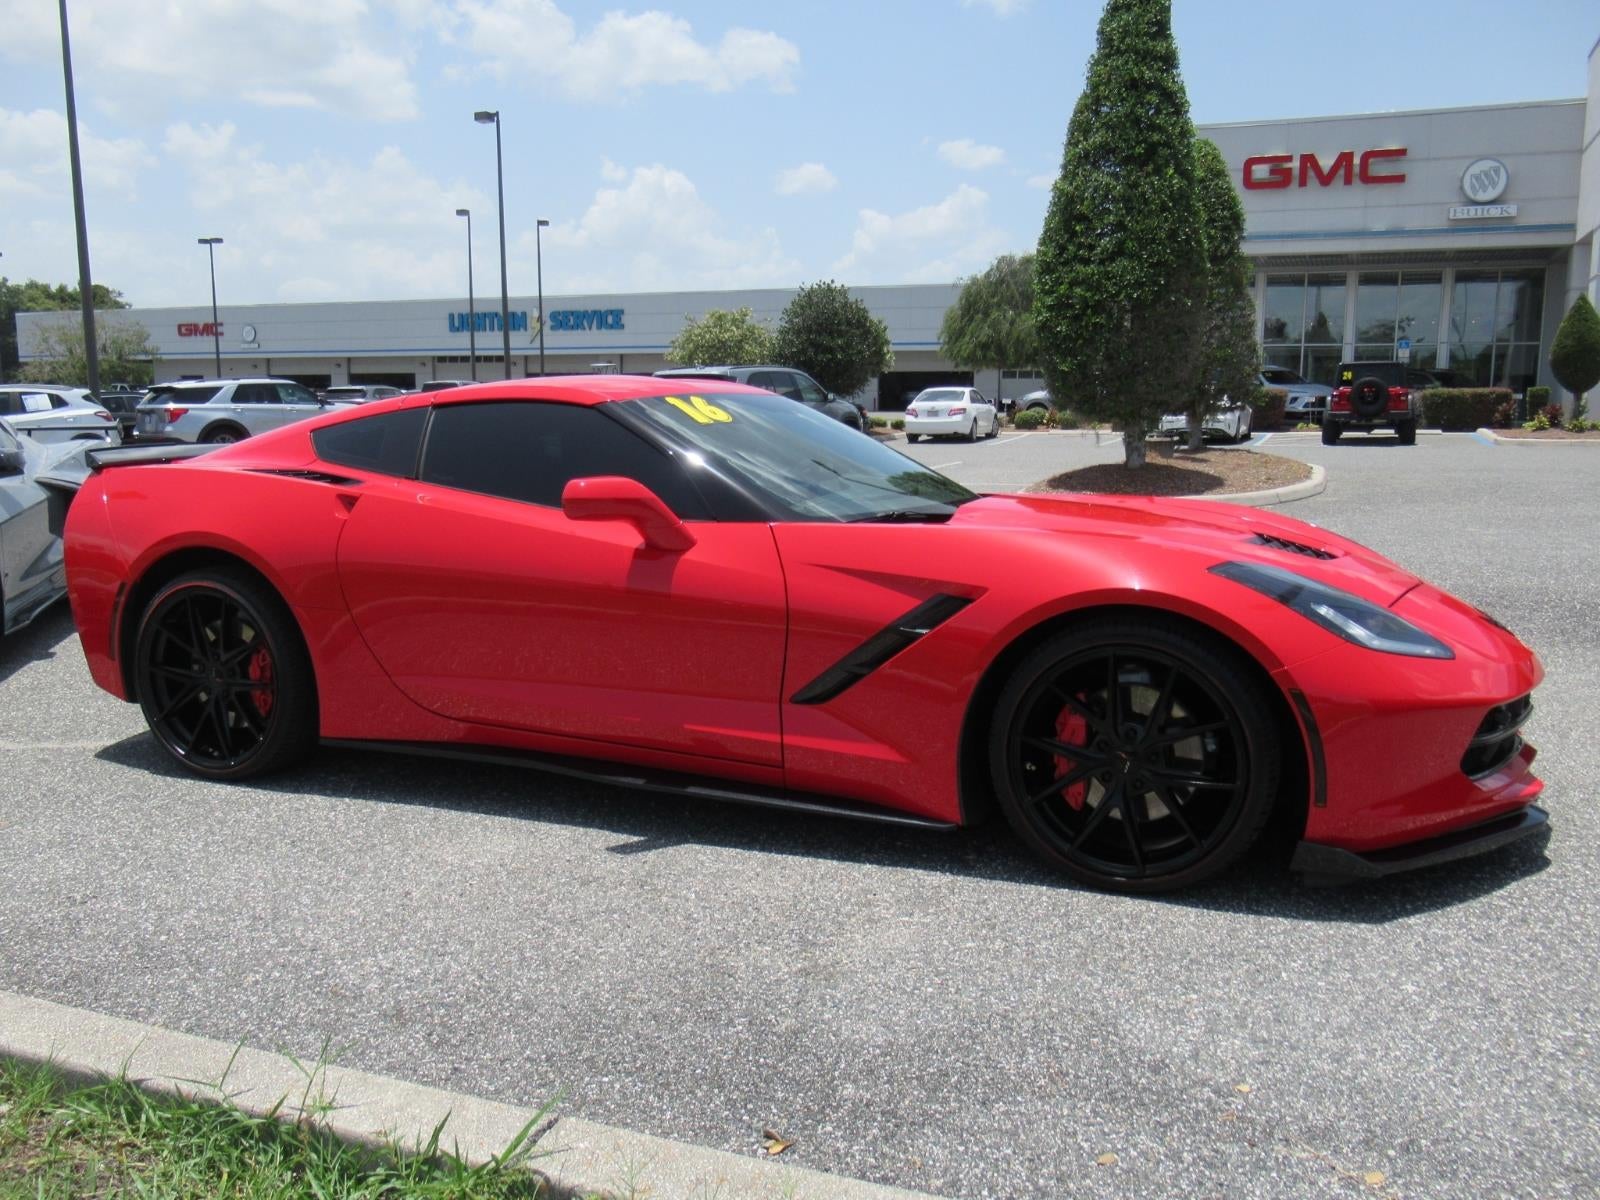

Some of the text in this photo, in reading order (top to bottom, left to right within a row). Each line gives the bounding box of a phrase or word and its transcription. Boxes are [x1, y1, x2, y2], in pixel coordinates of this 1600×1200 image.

[1243, 148, 1407, 190] GMC
[1452, 206, 1512, 218] BUICK
[176, 322, 224, 337] GMC
[549, 309, 625, 331] SERVICE
[664, 395, 733, 425] 16
